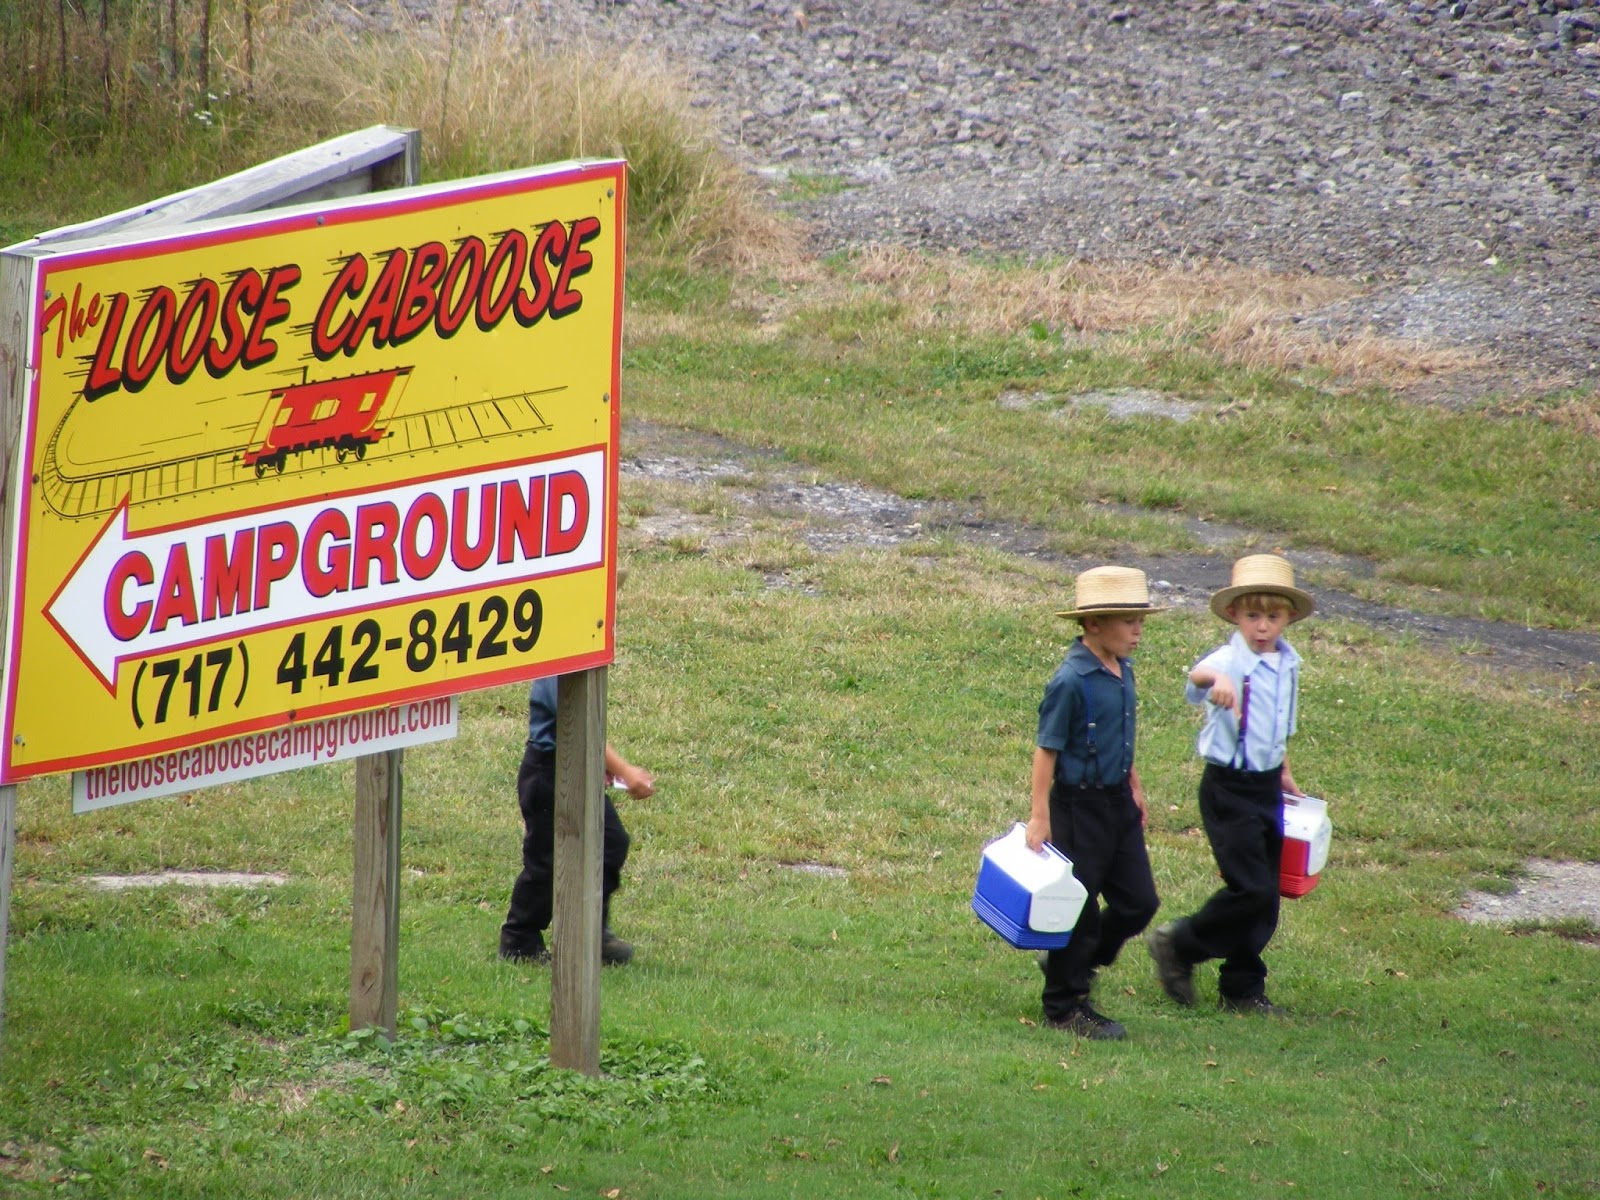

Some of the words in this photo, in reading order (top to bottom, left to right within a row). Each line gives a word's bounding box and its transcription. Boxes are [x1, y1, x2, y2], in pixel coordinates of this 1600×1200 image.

[41, 282, 104, 358] The
[83, 264, 301, 402] LOOSE
[312, 217, 600, 361] CABOOSE
[104, 470, 590, 642] CAMPGROUND
[131, 641, 249, 729] (717)
[277, 588, 543, 694] 442-8429
